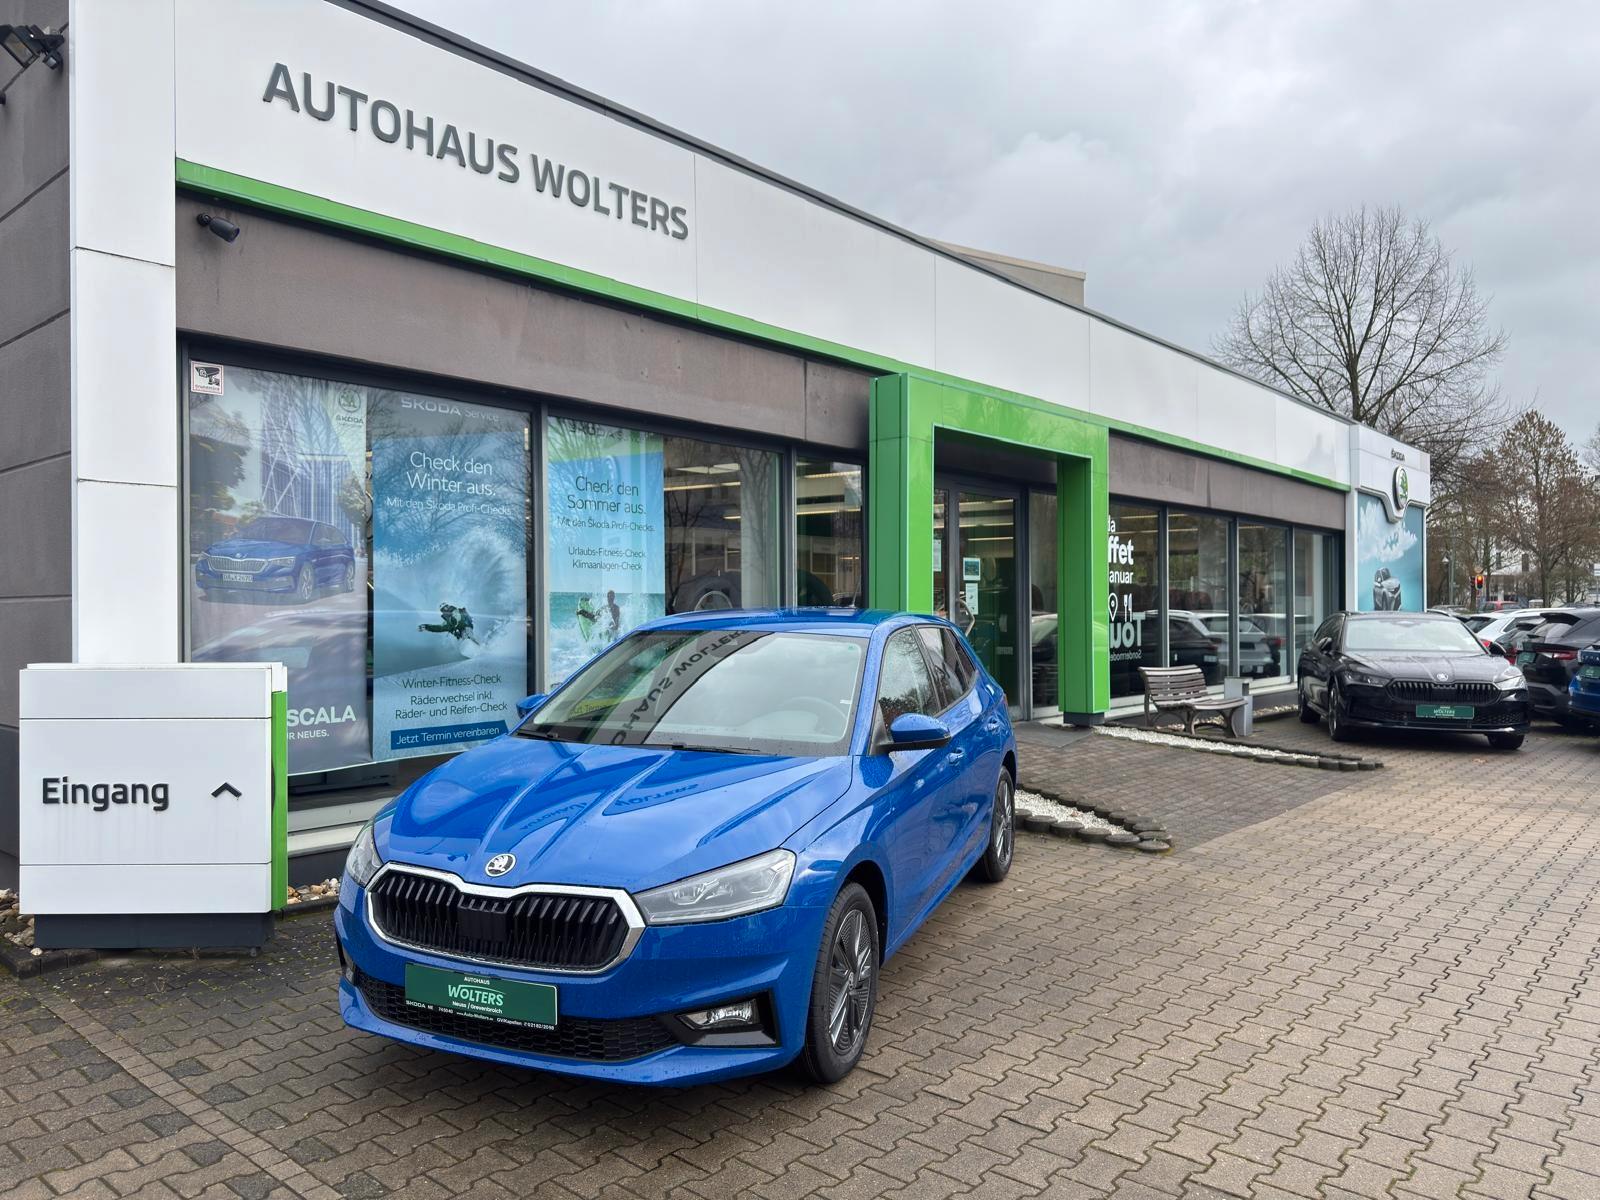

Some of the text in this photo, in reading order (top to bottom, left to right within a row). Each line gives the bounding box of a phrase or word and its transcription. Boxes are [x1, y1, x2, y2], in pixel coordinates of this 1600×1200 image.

[263, 62, 689, 241] AUTOHAUS WOLTERS
[410, 451, 493, 476] Check den
[406, 471, 497, 496] Winter aus.
[575, 475, 639, 496] Check den
[405, 498, 424, 509] den
[567, 495, 648, 515] Sommer aus.
[572, 518, 587, 528] den
[568, 546, 646, 558] Urlaubs-Fitness-Check
[572, 559, 643, 572] Klimaanlagen-Check
[402, 674, 502, 689] Winter-Fitness-Check
[410, 691, 475, 706] Räderwechsel
[287, 705, 357, 727] SCALA
[395, 701, 508, 720] Räder- und Reifen-Check
[297, 729, 330, 740] NEUES.
[396, 726, 500, 745] Jetzt Termin vereinbaren
[42, 776, 169, 812] Eingang
[463, 976, 491, 986] AUTOHAUS
[448, 985, 505, 1006] WOLTERS
